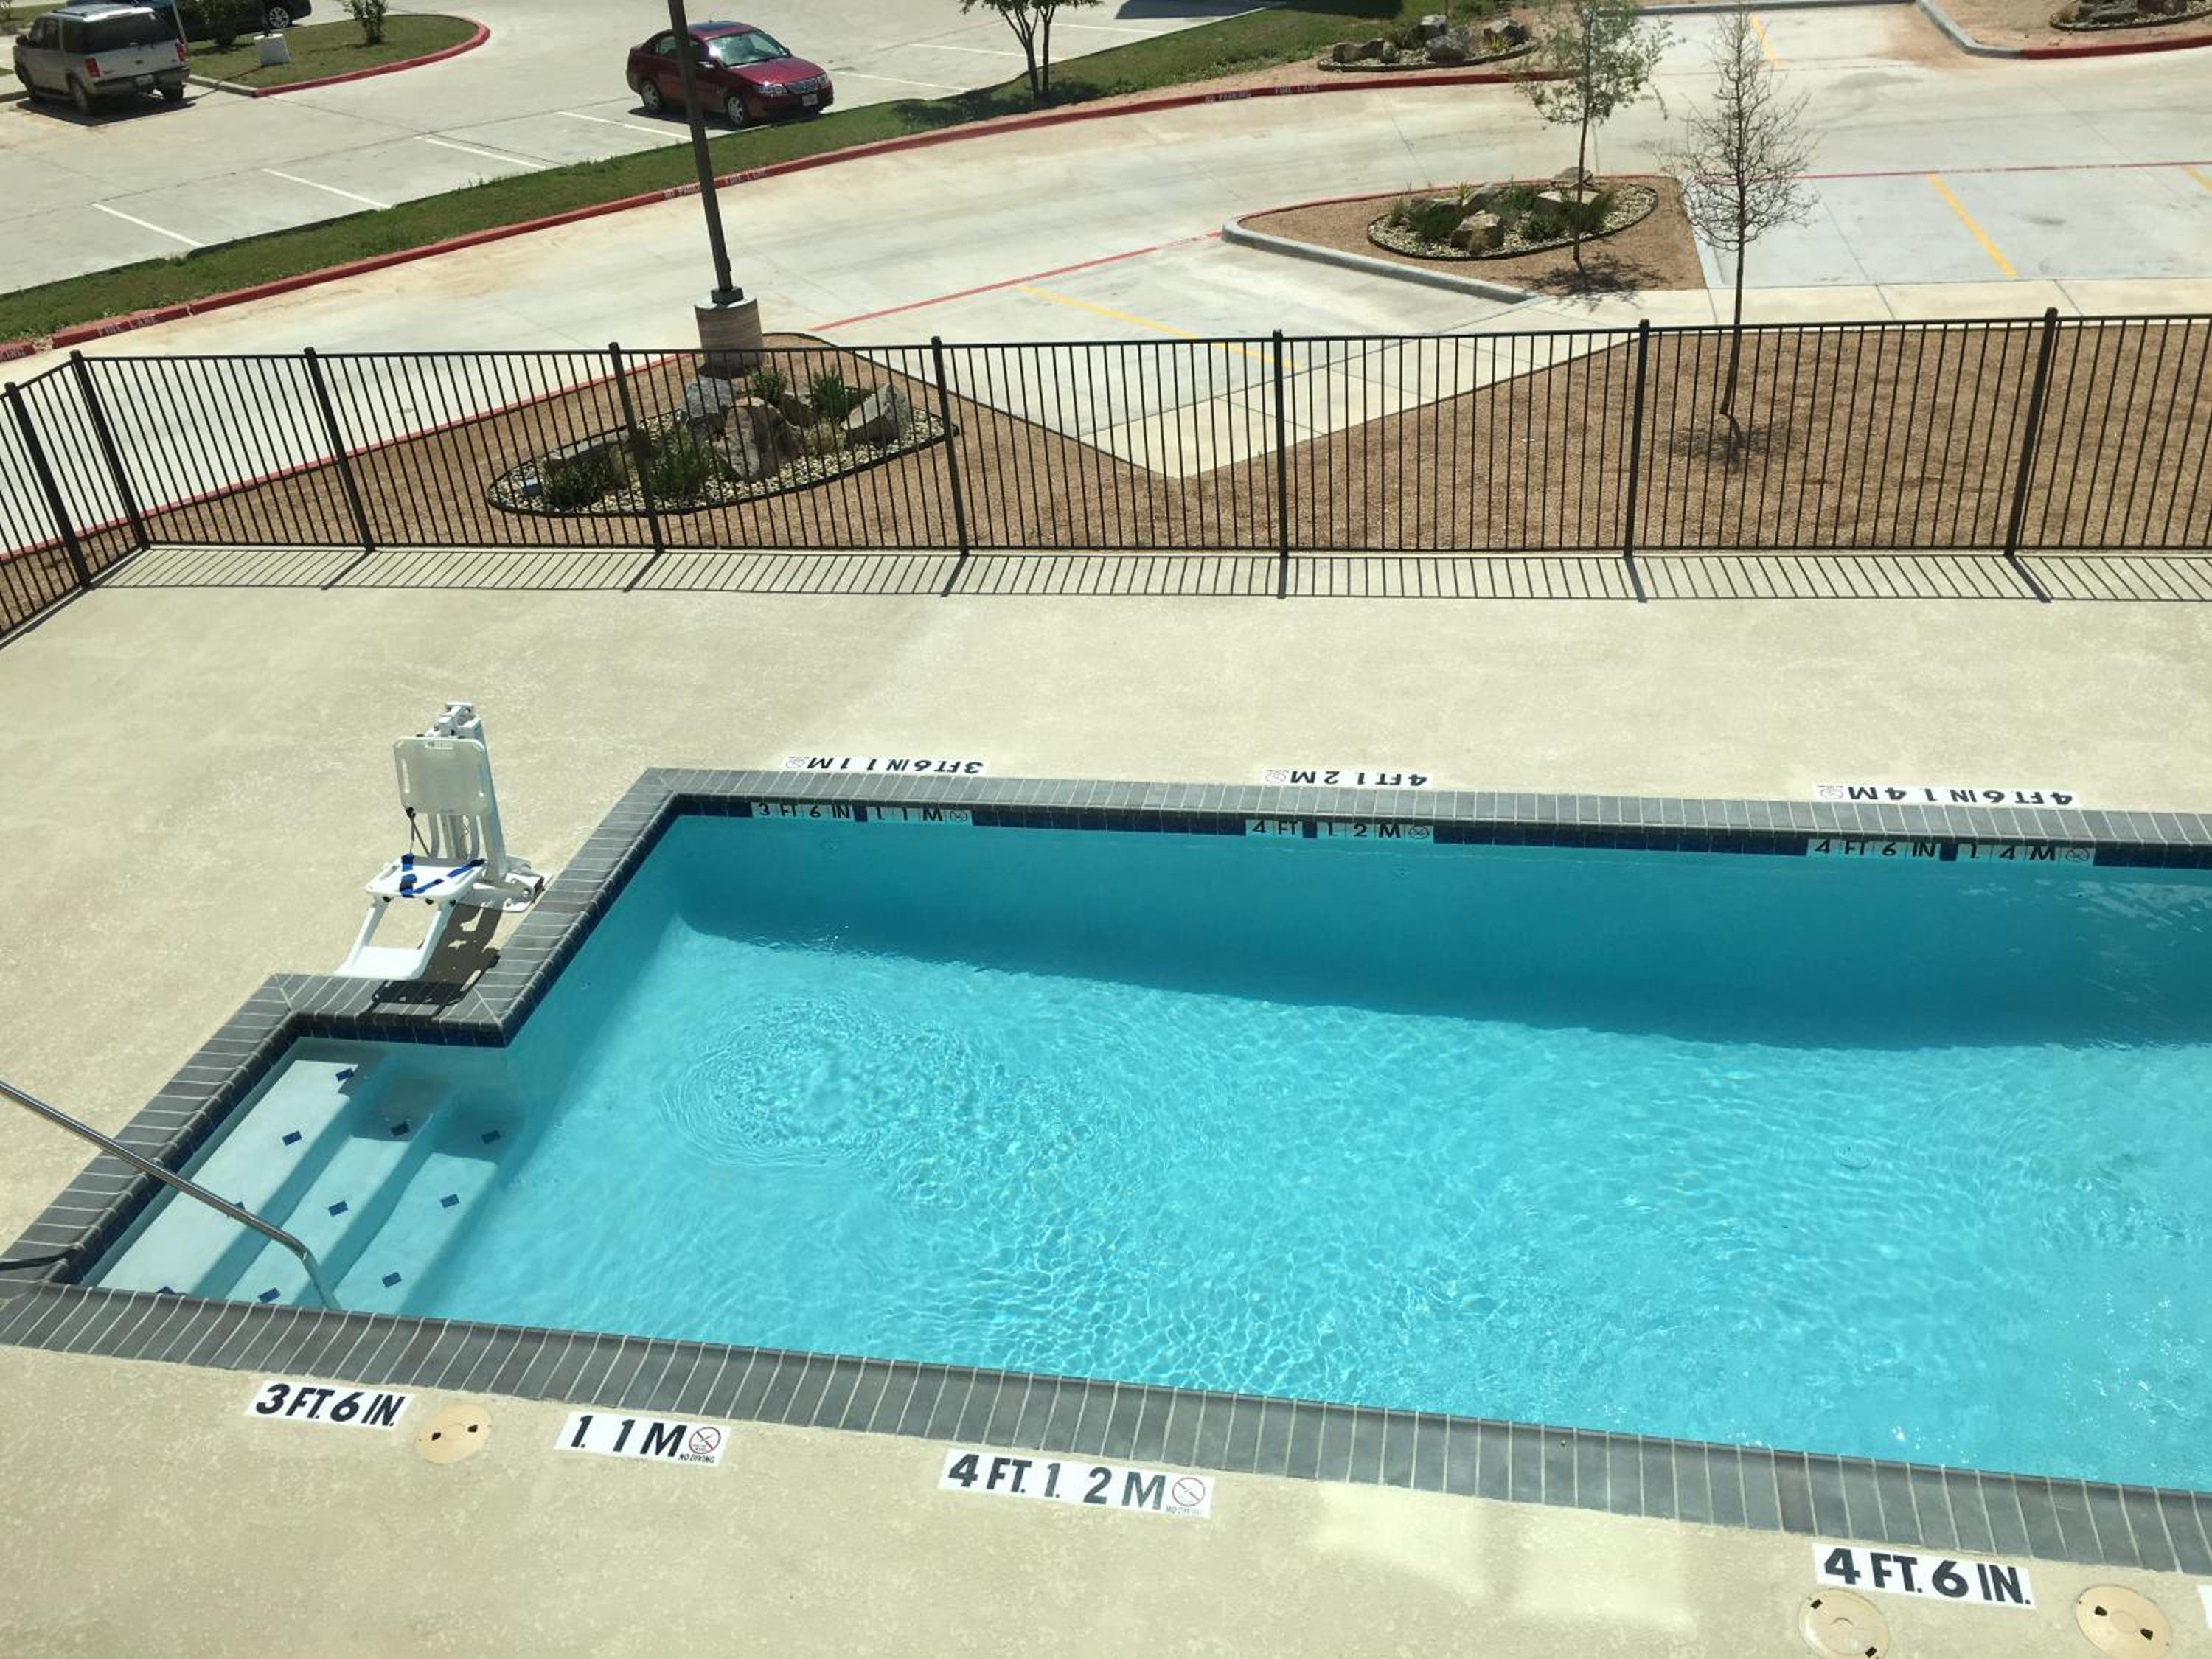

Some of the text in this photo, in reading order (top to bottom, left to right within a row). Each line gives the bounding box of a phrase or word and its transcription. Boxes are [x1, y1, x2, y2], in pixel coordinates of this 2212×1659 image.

[758, 803, 770, 816] 3
[809, 805, 821, 818] 6
[1253, 821, 1298, 835] 4 FT
[1378, 824, 1401, 838] M
[1815, 840, 1830, 854] 4
[1882, 842, 1896, 856] 6
[256, 1383, 291, 1415] 3
[330, 1391, 366, 1422] 6
[639, 1422, 688, 1458] M
[948, 1453, 980, 1487] 4
[1083, 1466, 1113, 1505] 2
[1121, 1470, 1166, 1511] M
[1823, 1547, 1862, 1585] 4
[1932, 1559, 1969, 1599] 6
